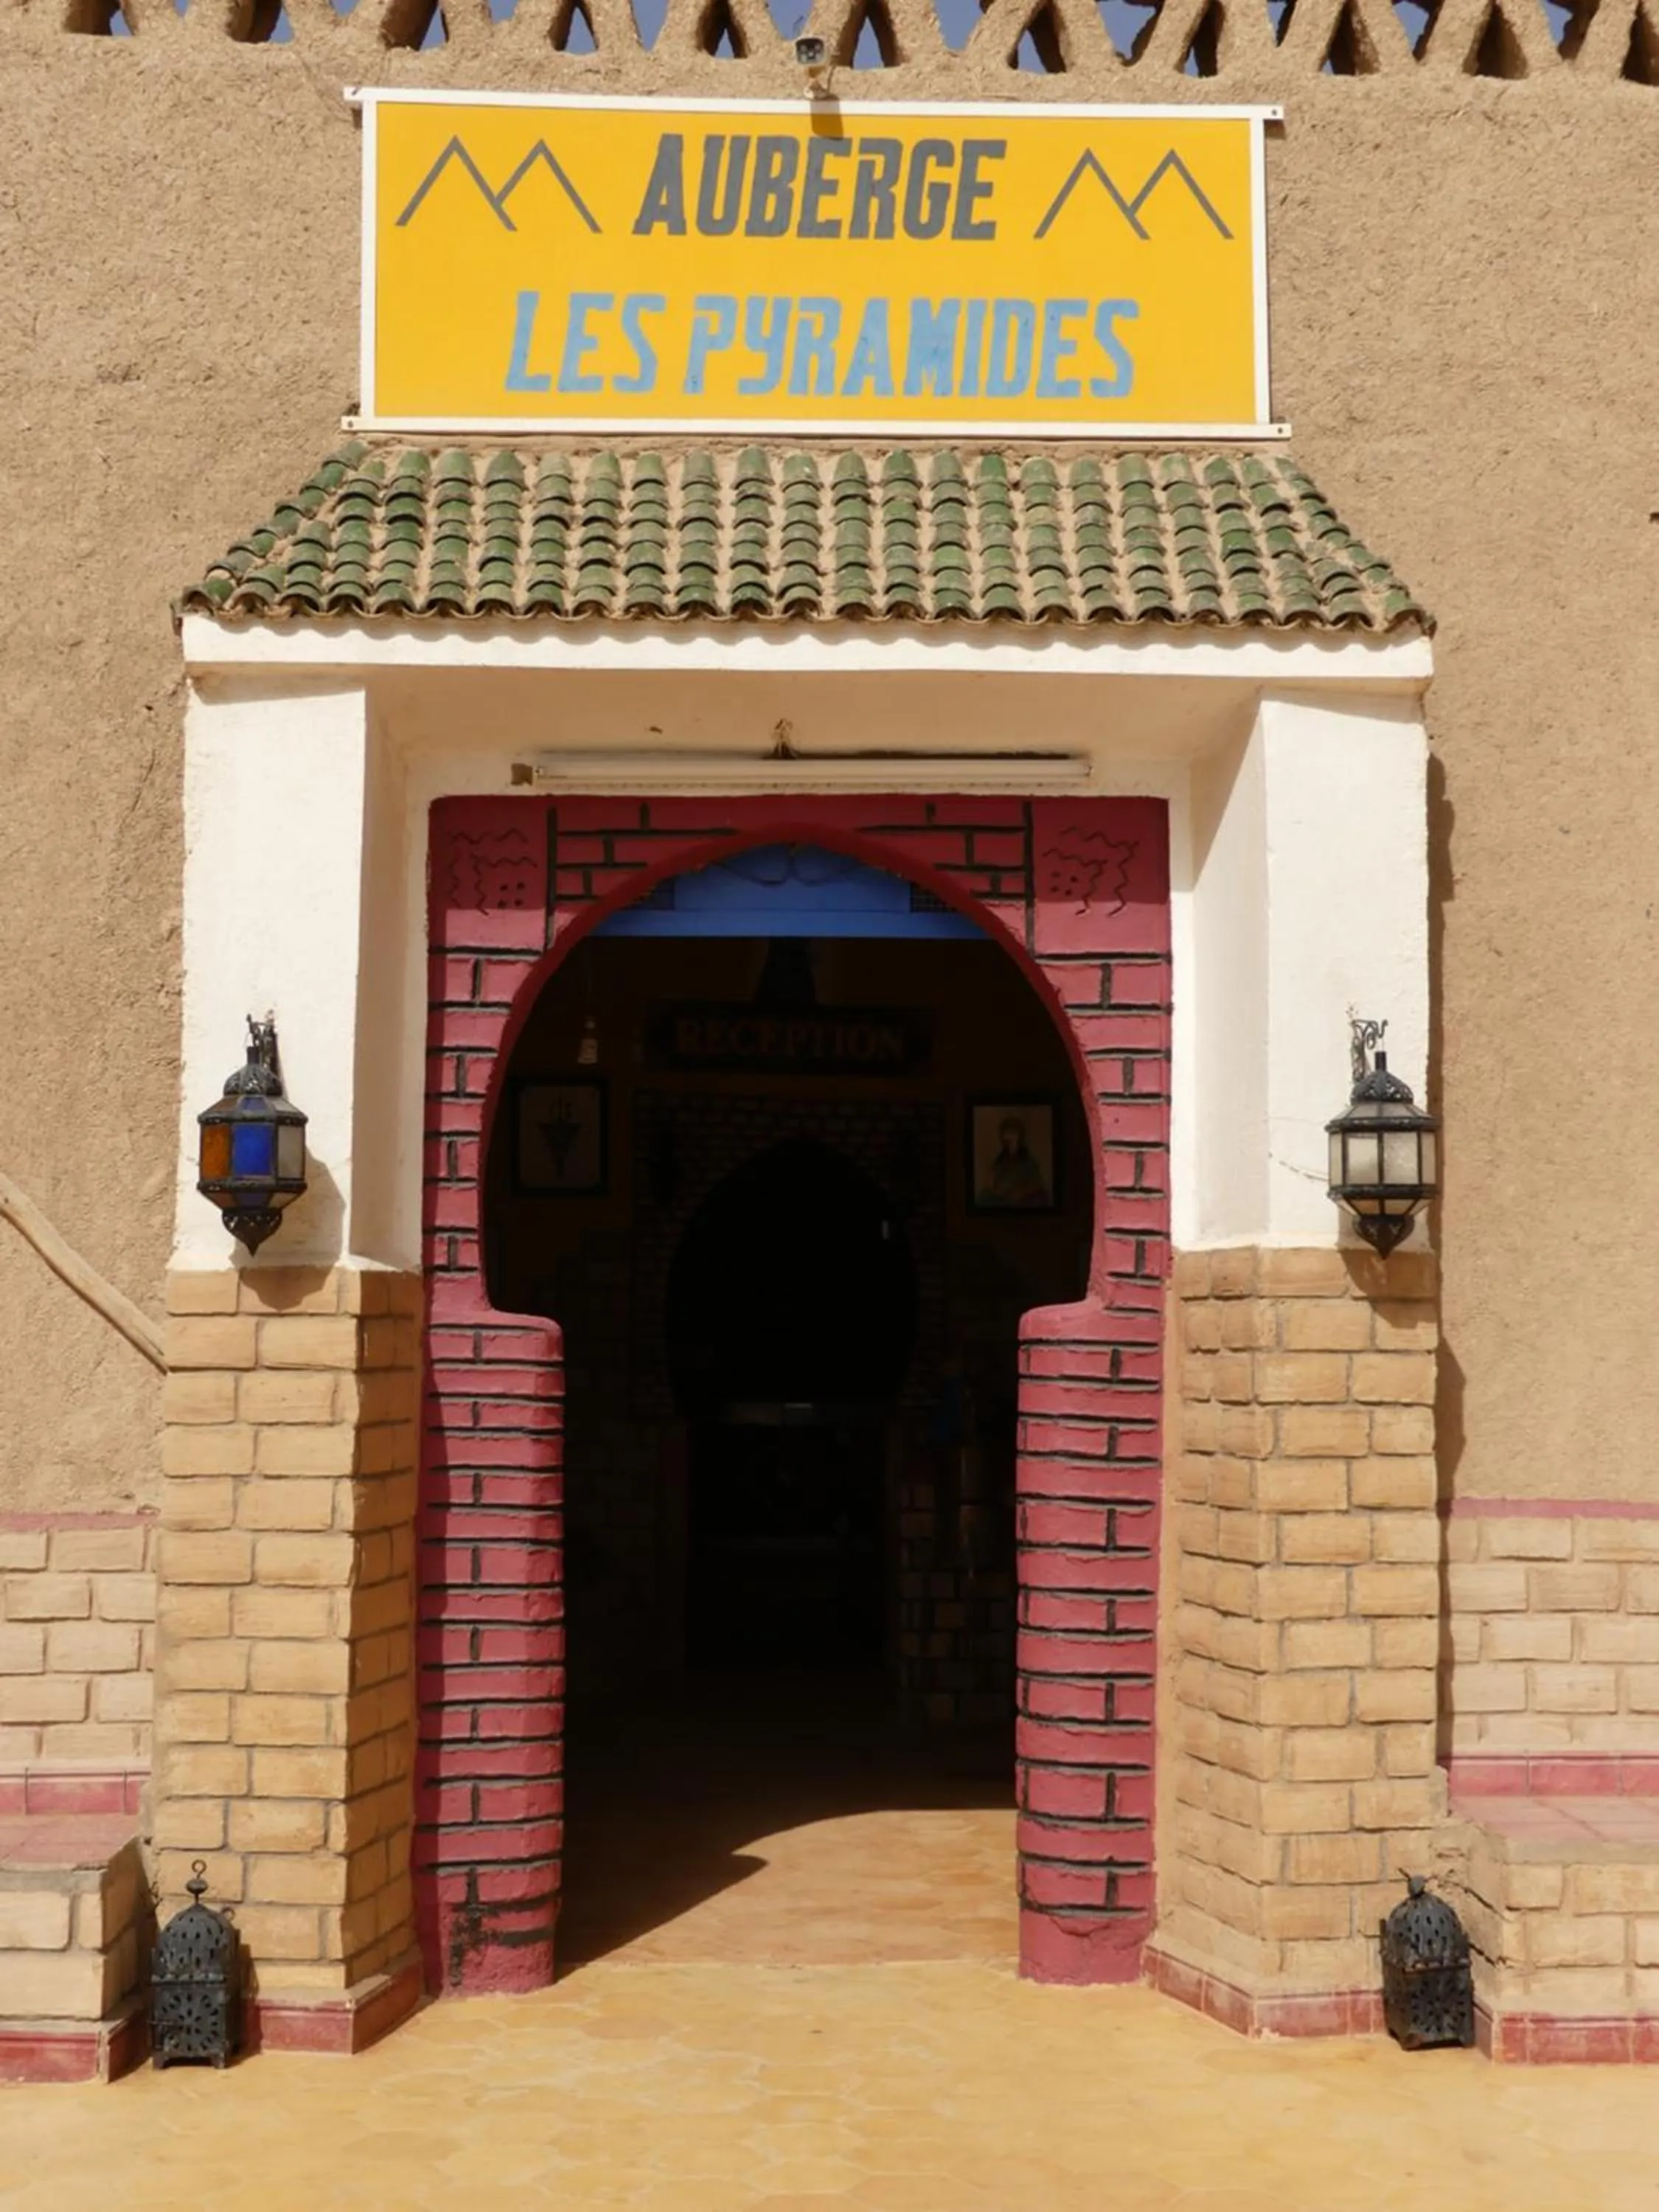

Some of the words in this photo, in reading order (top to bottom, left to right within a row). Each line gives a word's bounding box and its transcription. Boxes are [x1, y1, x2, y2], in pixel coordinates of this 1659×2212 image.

[633, 132, 1006, 240] AUBERGE
[503, 288, 668, 395] LES
[681, 293, 1141, 400] PYRAMIDES
[674, 1017, 905, 1062] RECEPTION
